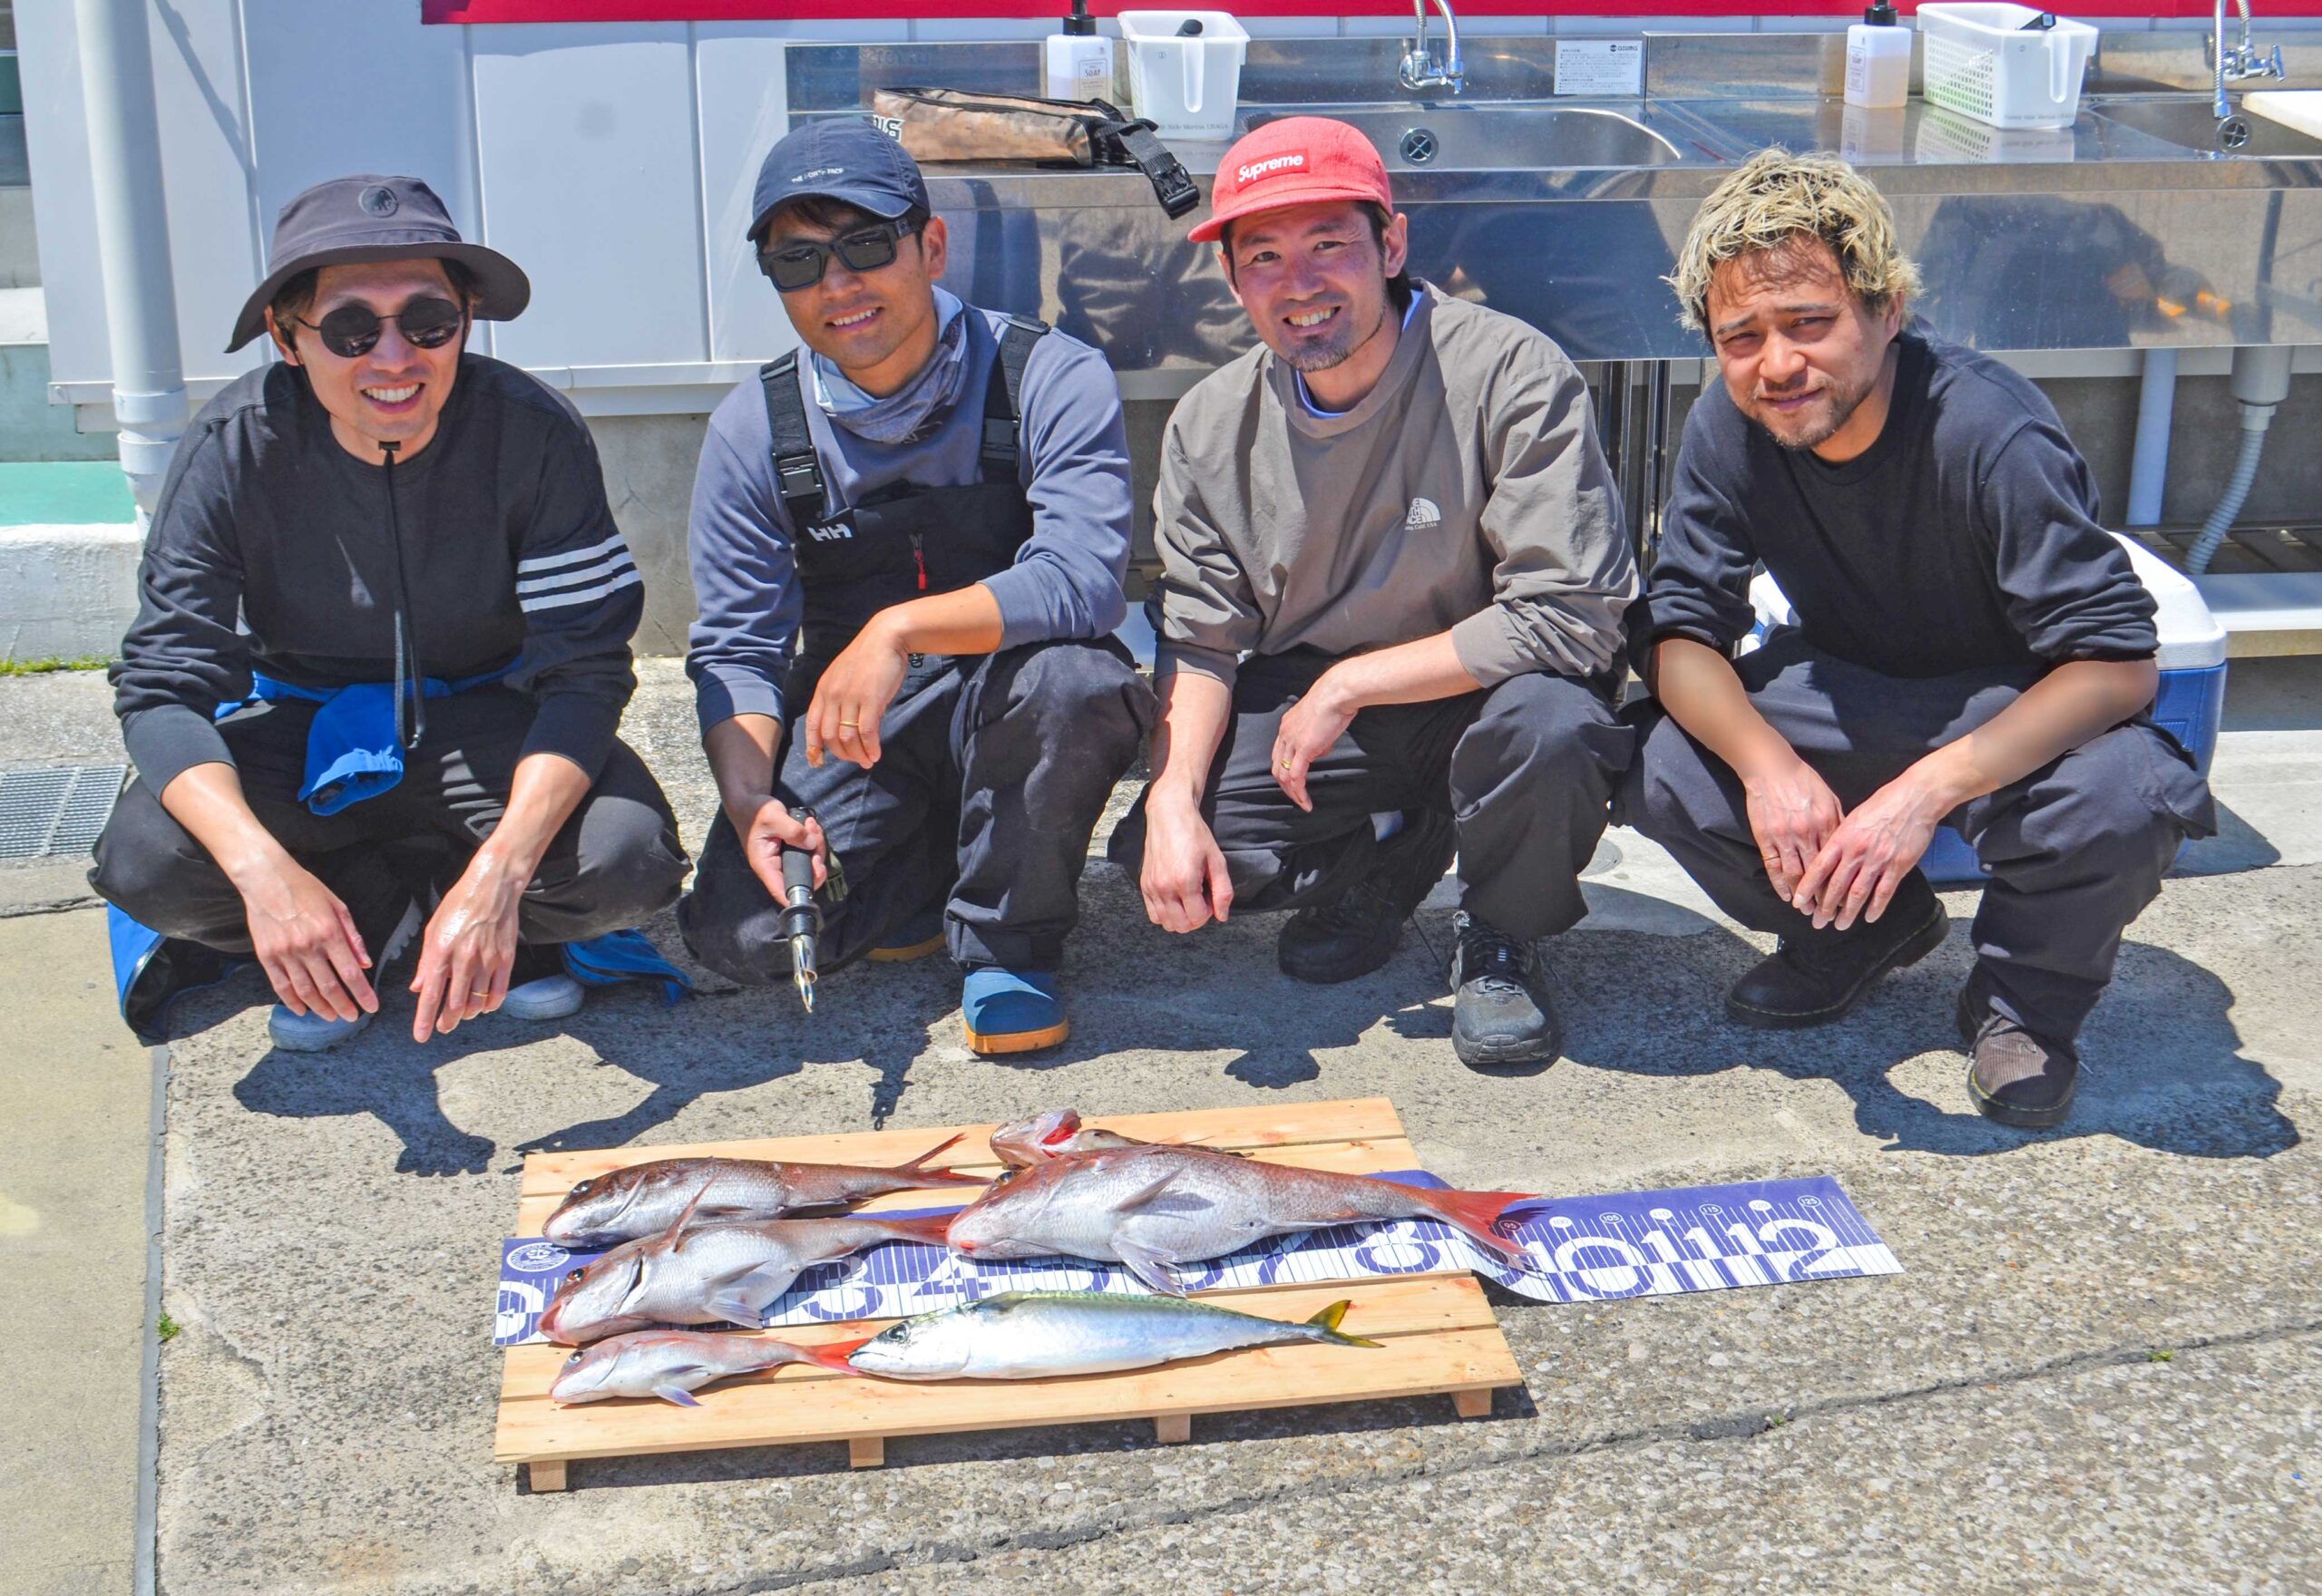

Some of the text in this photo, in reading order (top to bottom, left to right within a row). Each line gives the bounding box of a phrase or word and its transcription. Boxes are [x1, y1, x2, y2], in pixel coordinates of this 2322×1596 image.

[1238, 155, 1303, 182] Supreme
[807, 523, 853, 541] HH
[912, 1254, 991, 1302] 4
[1354, 1221, 1441, 1275] 8
